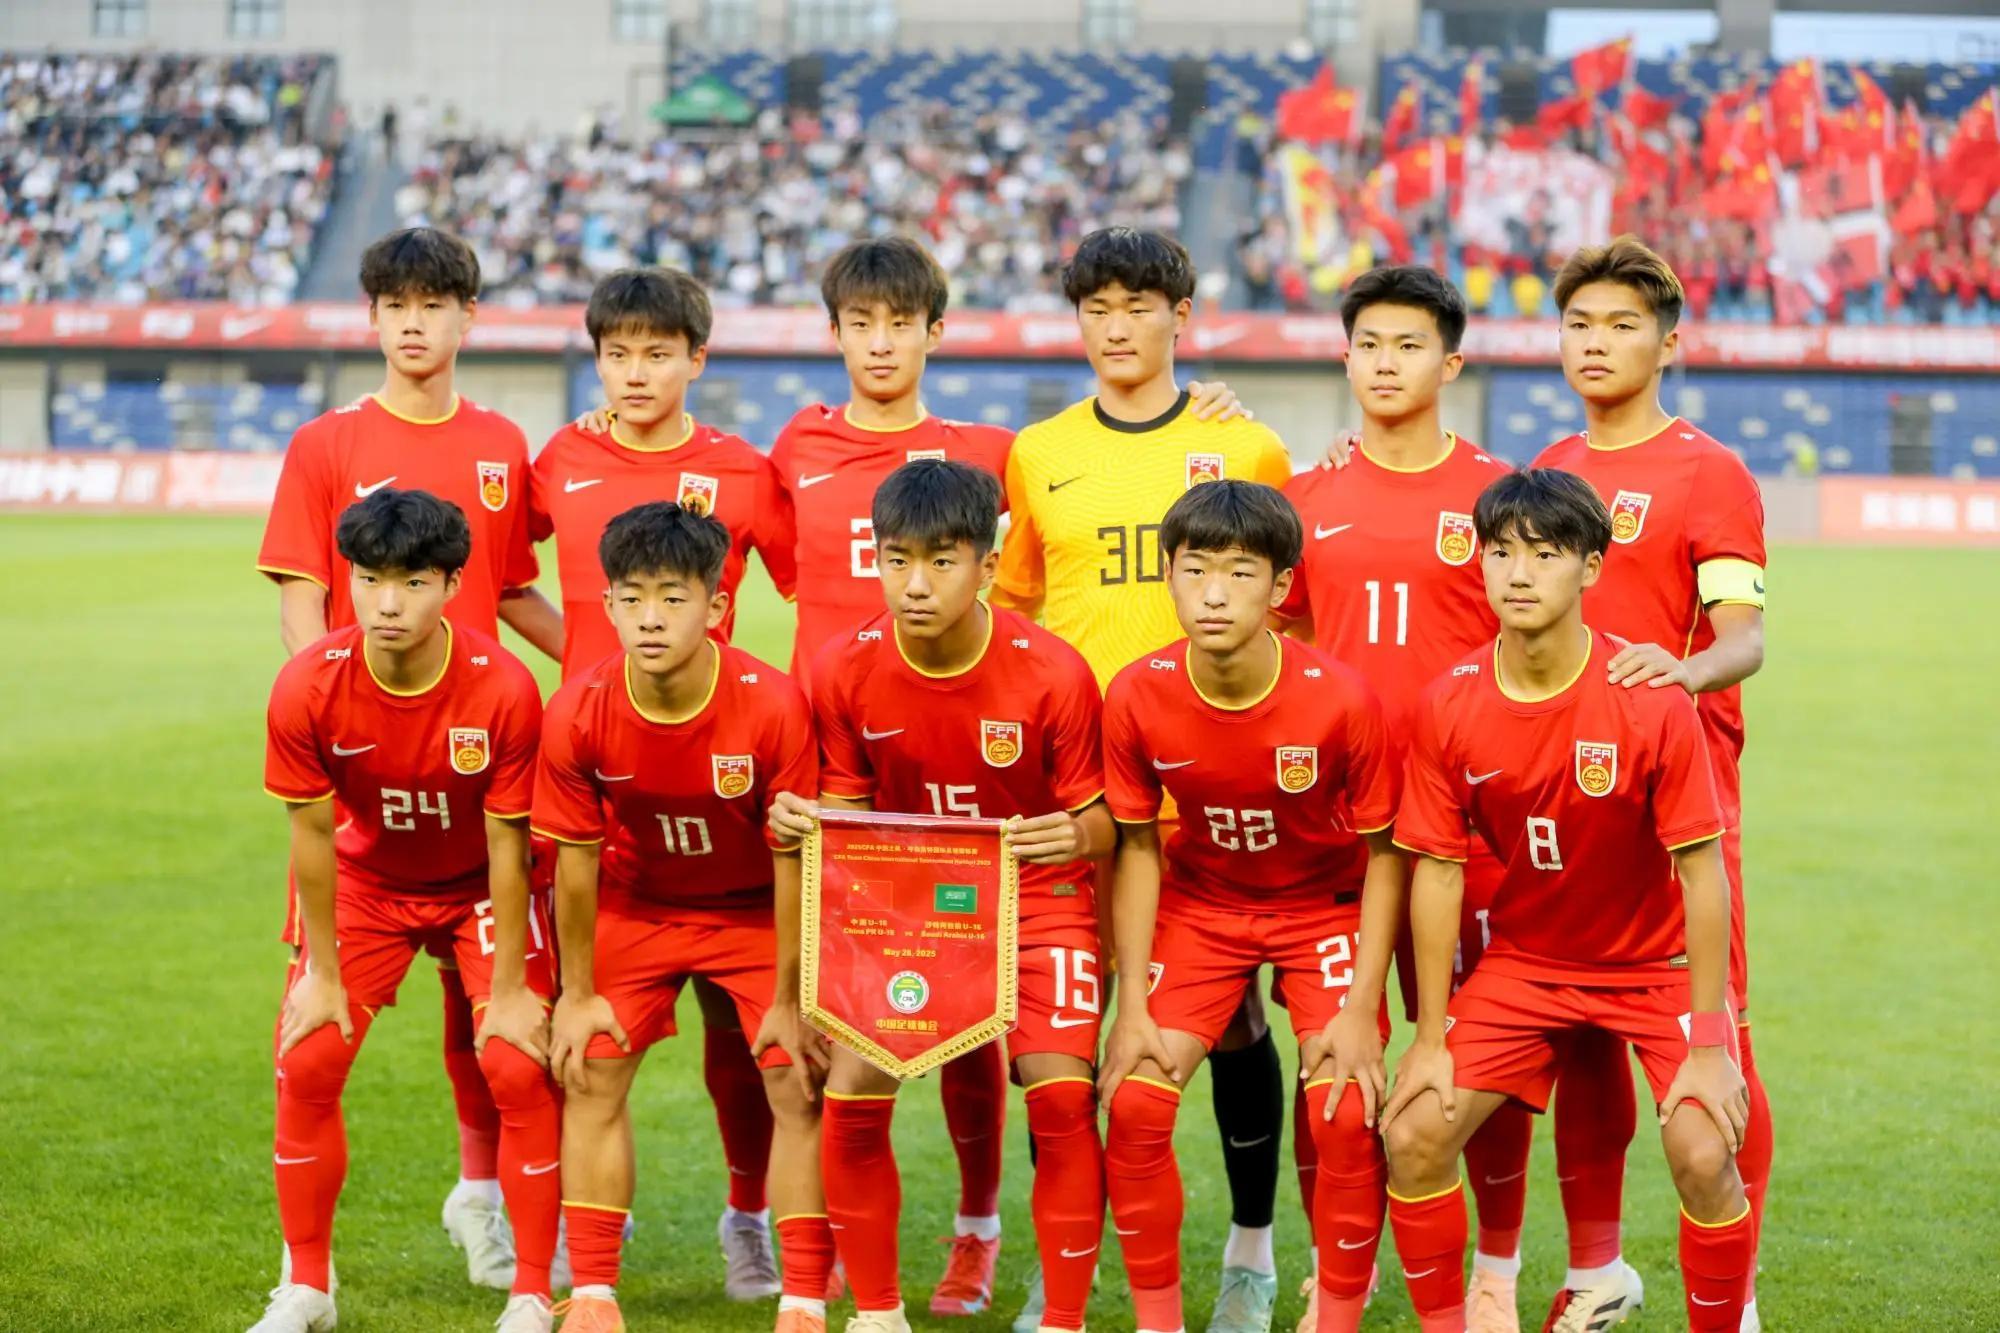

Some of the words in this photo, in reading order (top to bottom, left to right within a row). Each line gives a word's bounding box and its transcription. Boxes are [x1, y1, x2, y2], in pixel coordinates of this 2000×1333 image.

[1444, 516, 1473, 530] CFA
[851, 518, 882, 577] 2
[1097, 523, 1165, 586] 30
[1365, 580, 1408, 646] 11
[857, 630, 883, 641] CFA
[325, 648, 351, 660] CFA
[1150, 658, 1176, 671] CFA
[1453, 664, 1479, 676] CFA
[986, 725, 1016, 734] CFA
[455, 733, 483, 742] CFA
[1282, 751, 1312, 760] CFA
[1581, 747, 1612, 759] CFA
[718, 759, 747, 769] CFA
[925, 782, 981, 819] 15
[380, 787, 450, 831] 24
[655, 813, 713, 856] 10
[1203, 805, 1278, 852] 22
[1526, 816, 1563, 870] 8
[921, 930, 942, 938] Saudi
[883, 948, 900, 958] May
[916, 949, 937, 958] 2025
[1050, 947, 1099, 1015] 15
